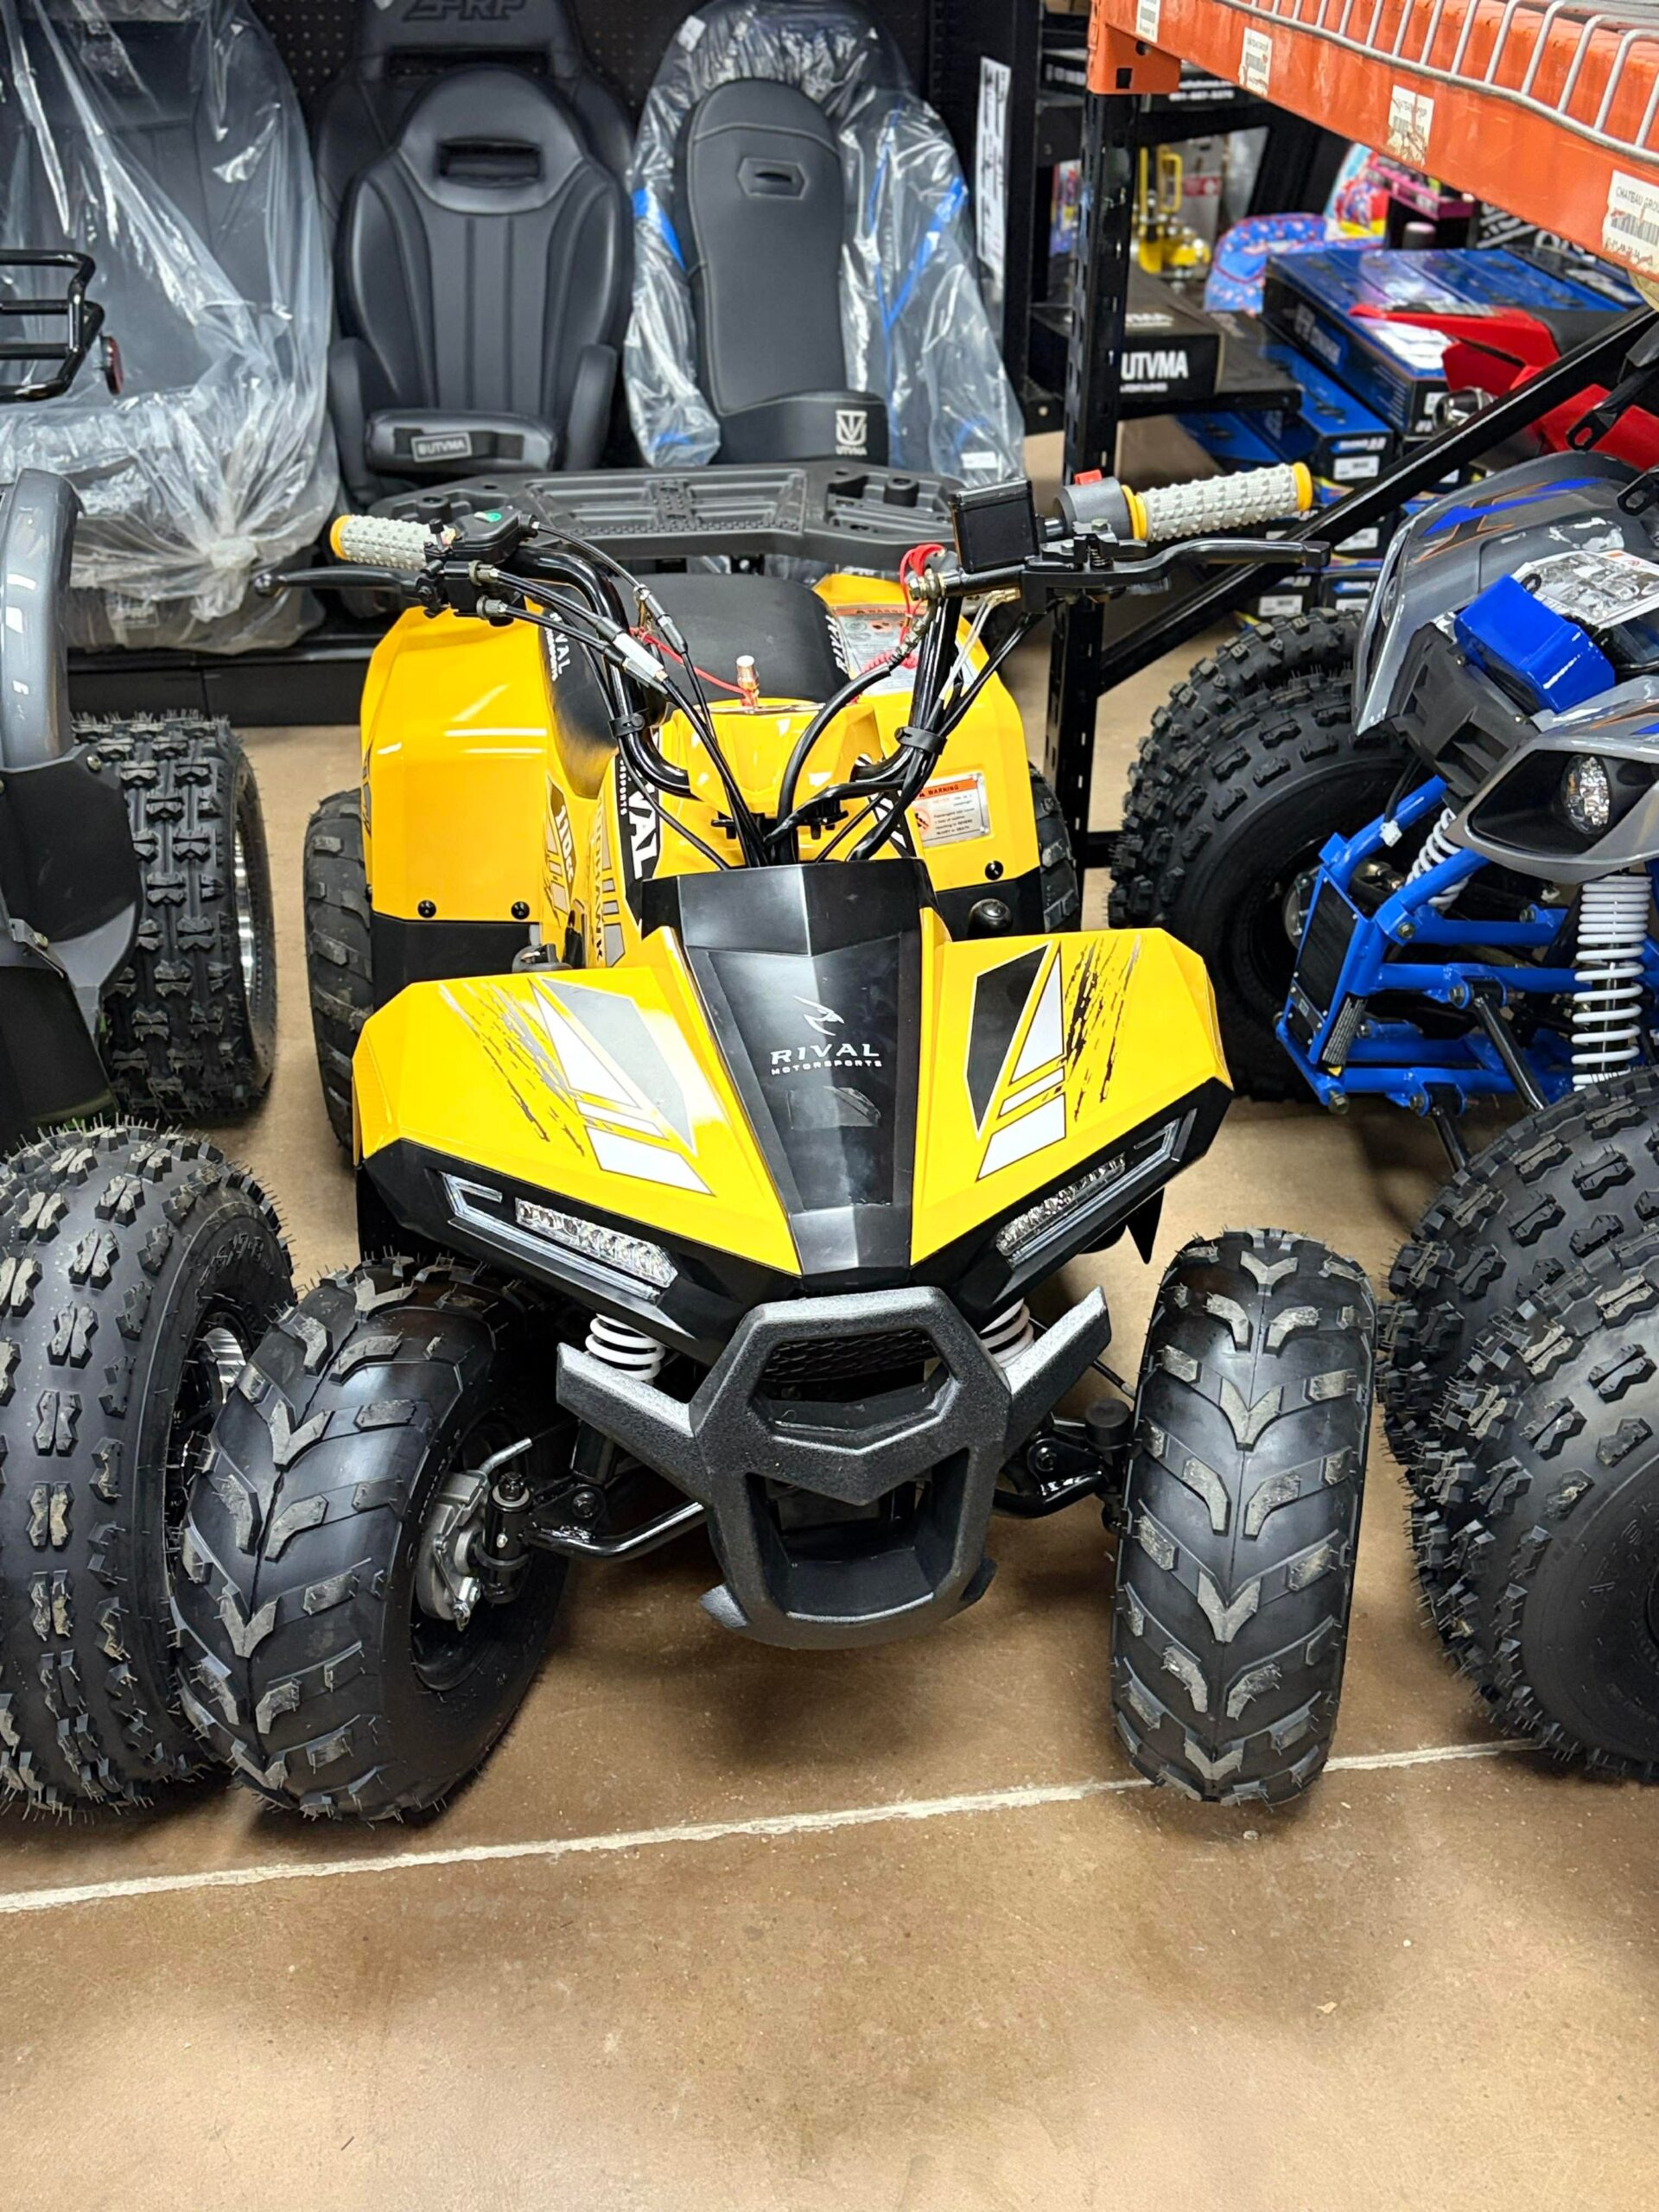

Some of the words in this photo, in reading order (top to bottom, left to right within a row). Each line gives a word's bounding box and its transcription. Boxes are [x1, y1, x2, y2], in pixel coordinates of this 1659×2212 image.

[1121, 350, 1189, 380] UTVMA
[928, 784, 960, 796] WARNING
[555, 804, 575, 883] 110cc
[770, 1043, 880, 1065] RIVAL
[771, 1059, 882, 1076] MOTORSPORTS
